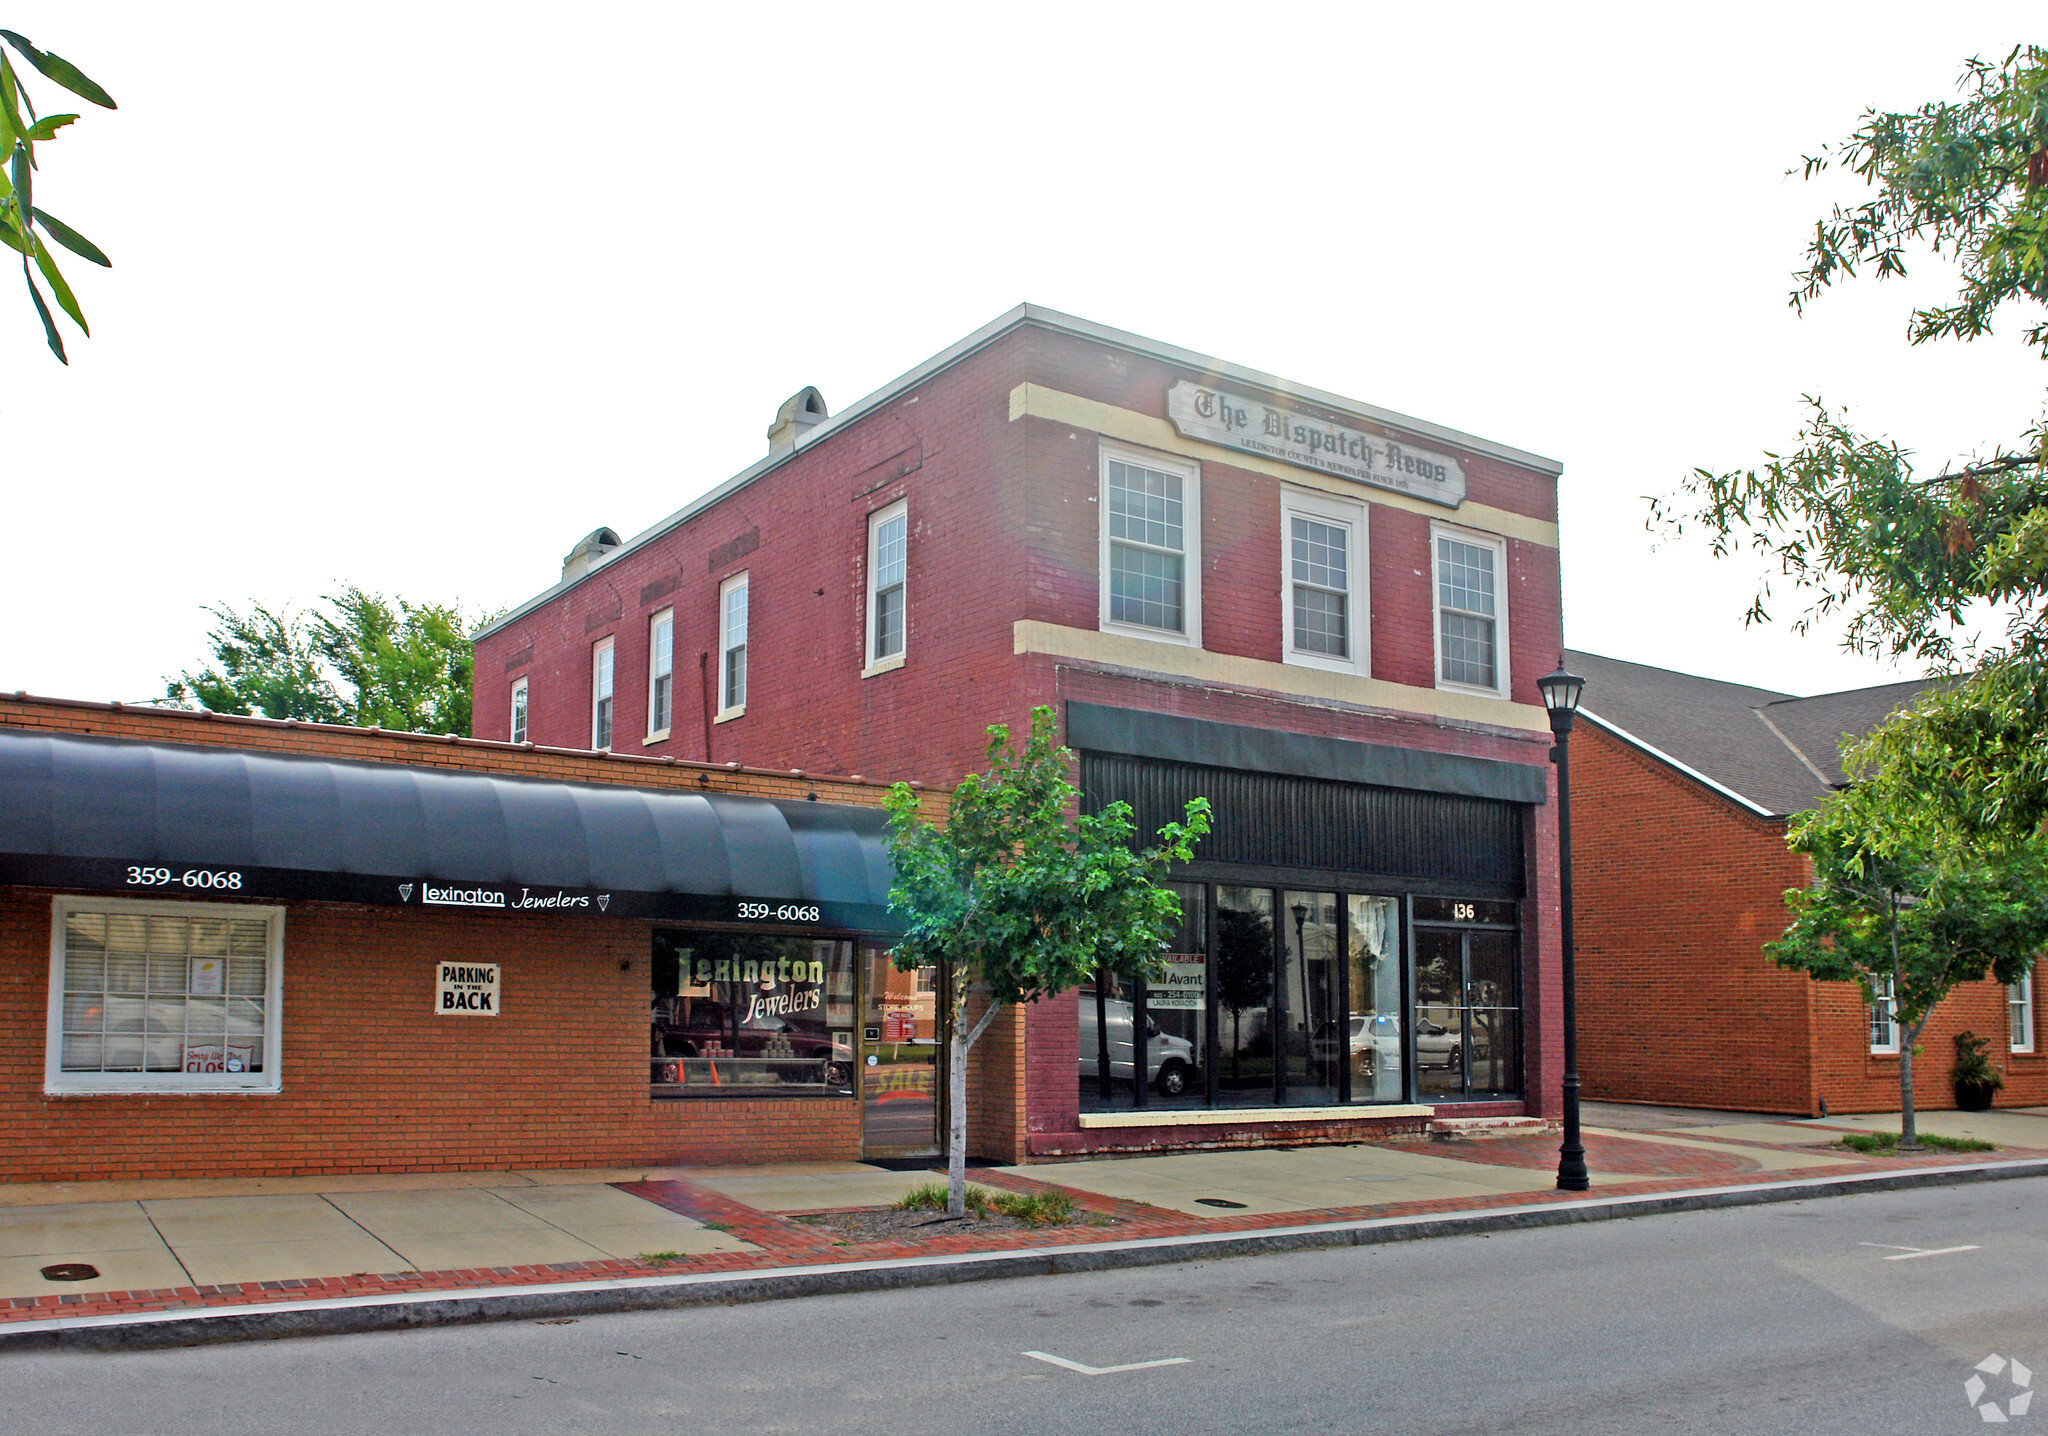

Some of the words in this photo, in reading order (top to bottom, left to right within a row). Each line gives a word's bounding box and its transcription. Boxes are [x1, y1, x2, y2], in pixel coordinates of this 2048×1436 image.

[1194, 388, 1248, 432] The
[1262, 406, 1447, 482] Dispatch-News
[1240, 438, 1286, 457] LEXINGTON
[1287, 449, 1325, 467] COUNTY'S
[1326, 459, 1372, 480] NEWSPAPER
[1372, 472, 1395, 486] SINCE
[125, 865, 243, 890] 359-6068
[422, 882, 506, 908] Lexington
[511, 887, 591, 909] Jewelers
[737, 902, 820, 922] 359-6068
[1454, 903, 1475, 919] 136
[1162, 954, 1199, 963] VAILABLE
[442, 966, 494, 984] PARKING
[674, 947, 825, 998] Lexington
[1169, 972, 1203, 985] Avant
[442, 991, 492, 1010] BACK
[742, 983, 822, 1025] Jewelers
[883, 990, 919, 1002] Welcome
[878, 1003, 899, 1011] STORE
[187, 1050, 209, 1063] Sorry
[876, 1069, 931, 1095] SALE
